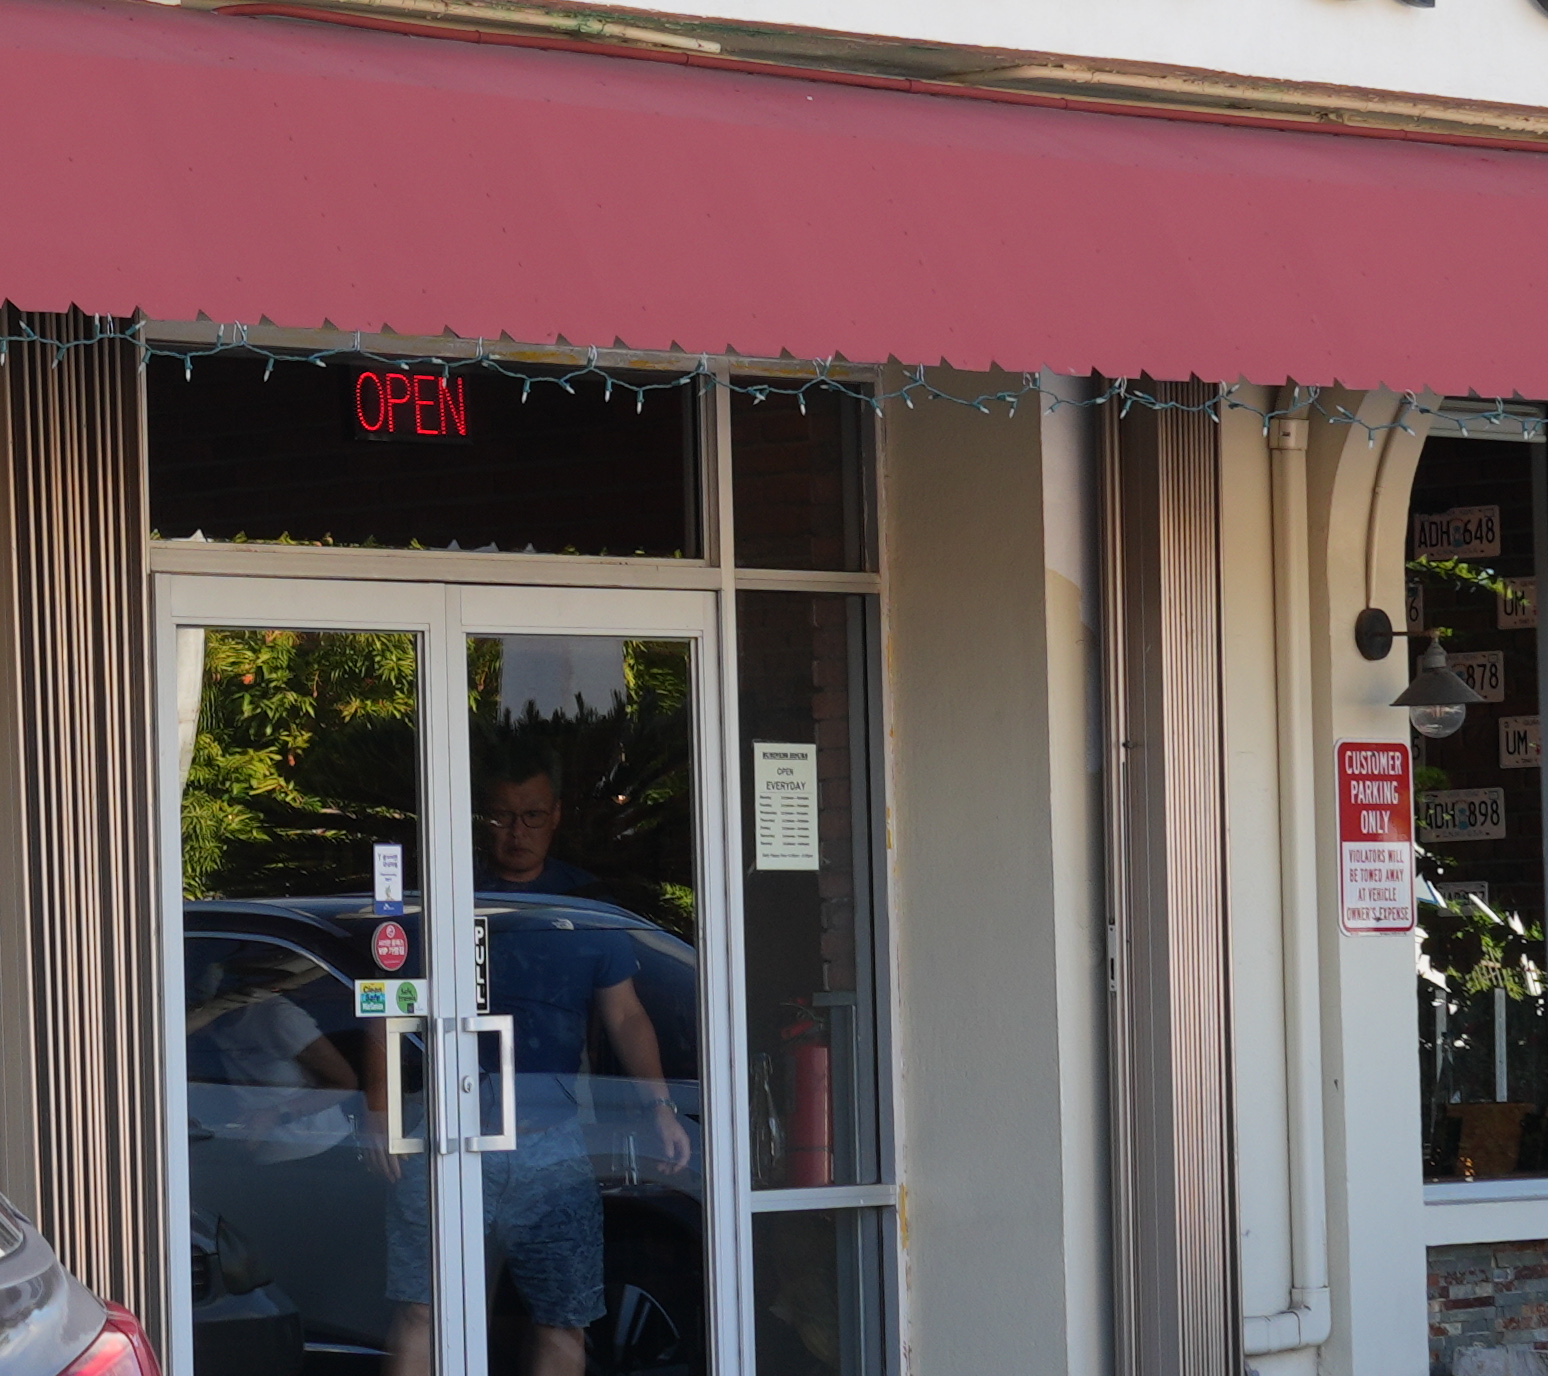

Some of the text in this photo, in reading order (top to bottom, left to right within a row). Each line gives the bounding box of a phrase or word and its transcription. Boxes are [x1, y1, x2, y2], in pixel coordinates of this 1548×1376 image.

[355, 371, 467, 436] OPEN
[1417, 516, 1496, 548] ADH 648
[1465, 663, 1499, 692] 878
[1506, 729, 1528, 755] UM
[776, 767, 794, 776] OPEN
[1345, 750, 1403, 775] CUSTOMER
[766, 781, 807, 790] EVERYDAY
[1350, 780, 1399, 804] PARKING
[1360, 810, 1391, 834] ONLY
[1467, 800, 1500, 827] 898
[1349, 849, 1404, 863] VIOLATORS WILL
[1349, 868, 1404, 882] BE TOWED AWAY
[1358, 887, 1397, 901] AT VEHICLE
[1347, 907, 1410, 921] OWNER'S EXPENSE
[474, 926, 485, 1004] PULL
